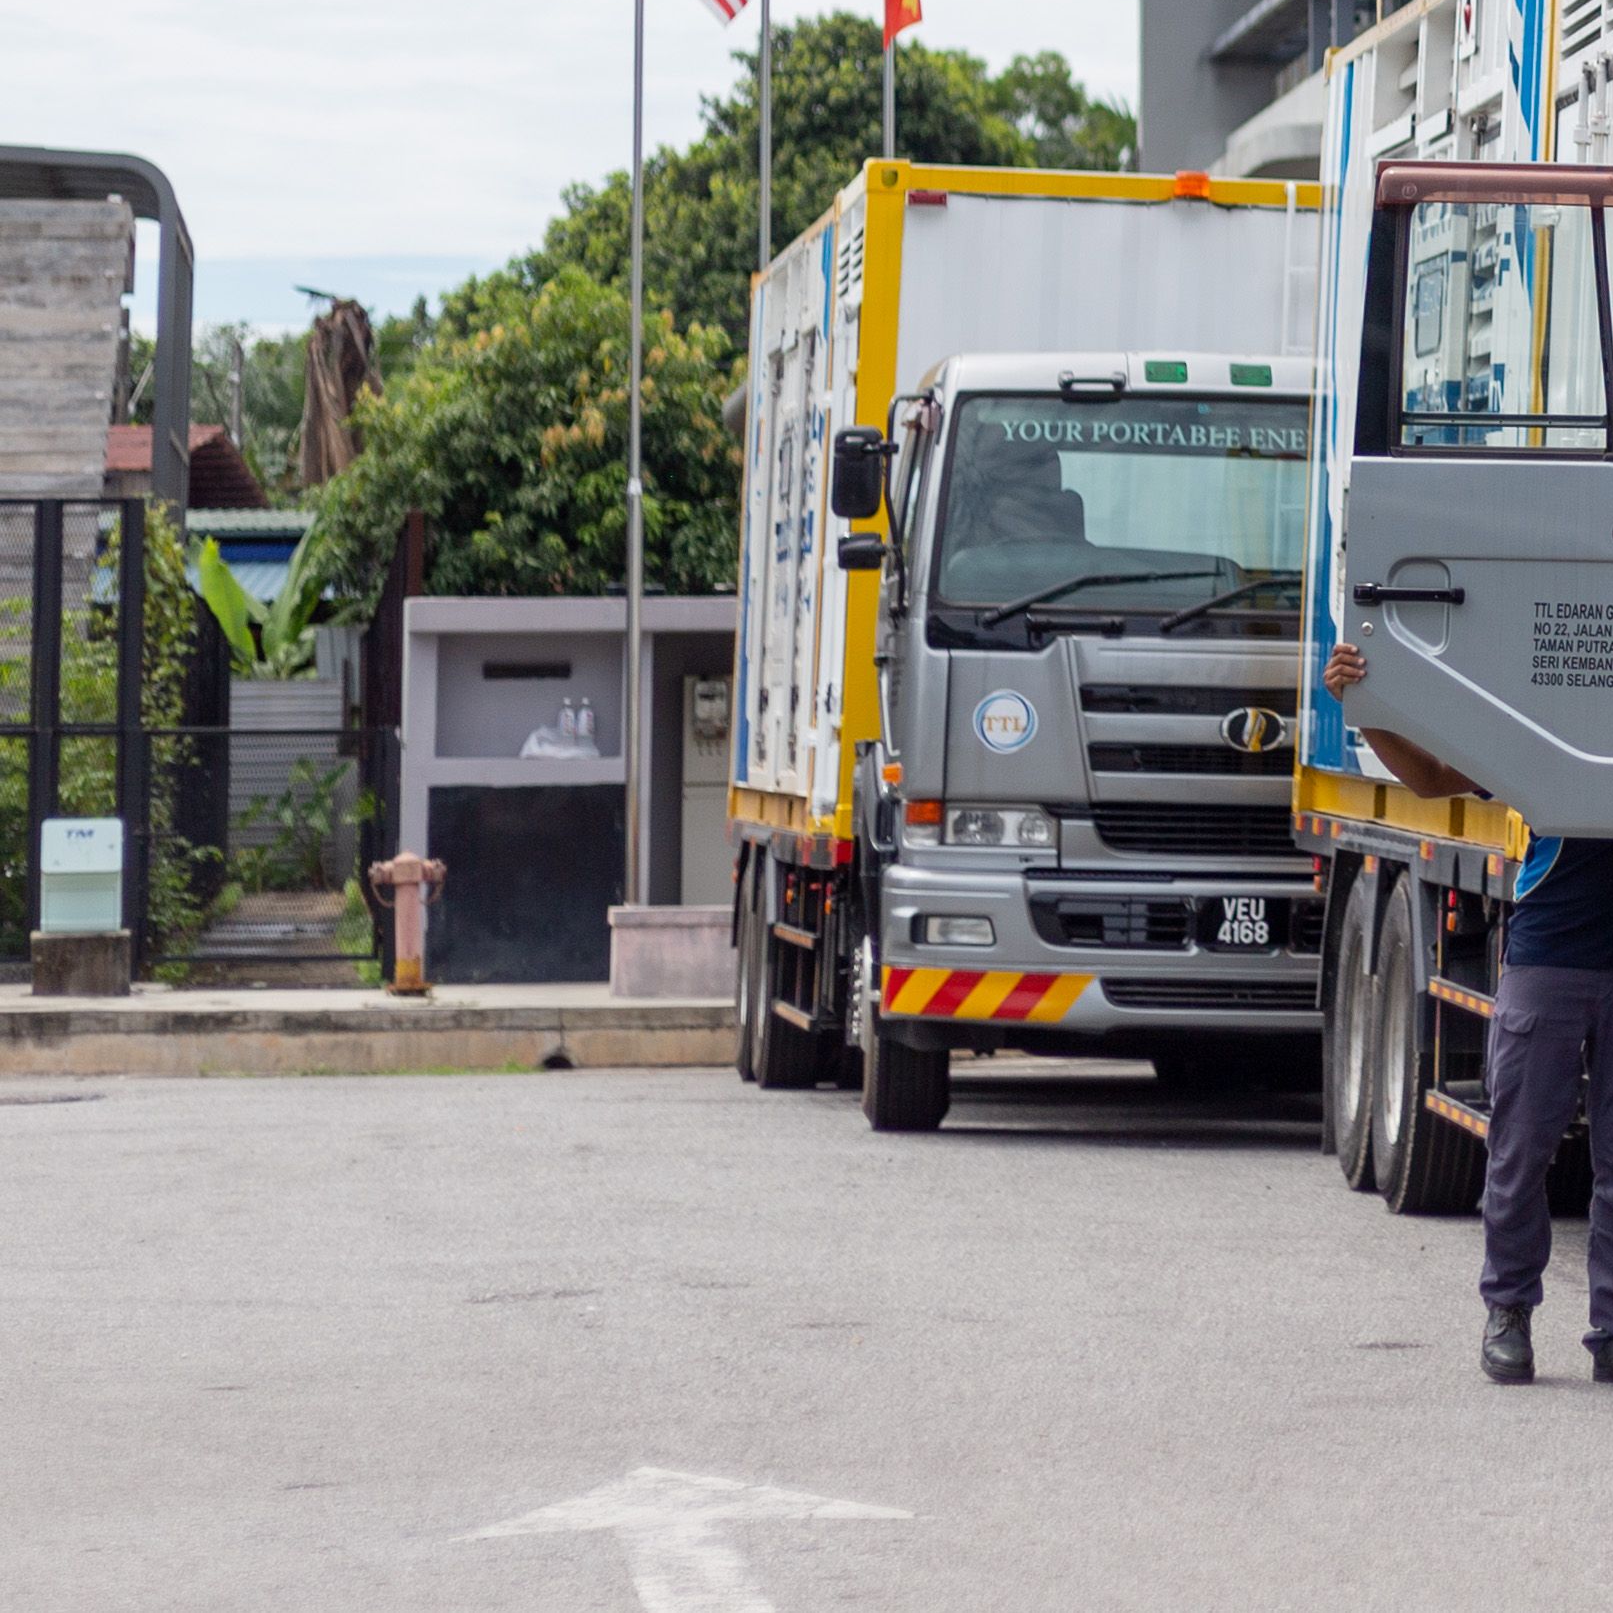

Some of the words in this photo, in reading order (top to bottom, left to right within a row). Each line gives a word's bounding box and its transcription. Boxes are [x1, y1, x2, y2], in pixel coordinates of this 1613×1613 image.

[1001, 419, 1083, 443] YOUR
[1092, 421, 1242, 448] PORTABLE
[1250, 427, 1308, 451] ENE
[1534, 602, 1553, 618] TTL
[1557, 603, 1603, 620] EDARAN
[1534, 622, 1550, 635] NO
[1573, 624, 1612, 638] JALAN
[1533, 639, 1573, 653] TAMAN
[1532, 655, 1559, 669] SERI
[1531, 672, 1563, 686] 43300
[1222, 897, 1265, 921] VEU
[1217, 920, 1269, 944] 4168
